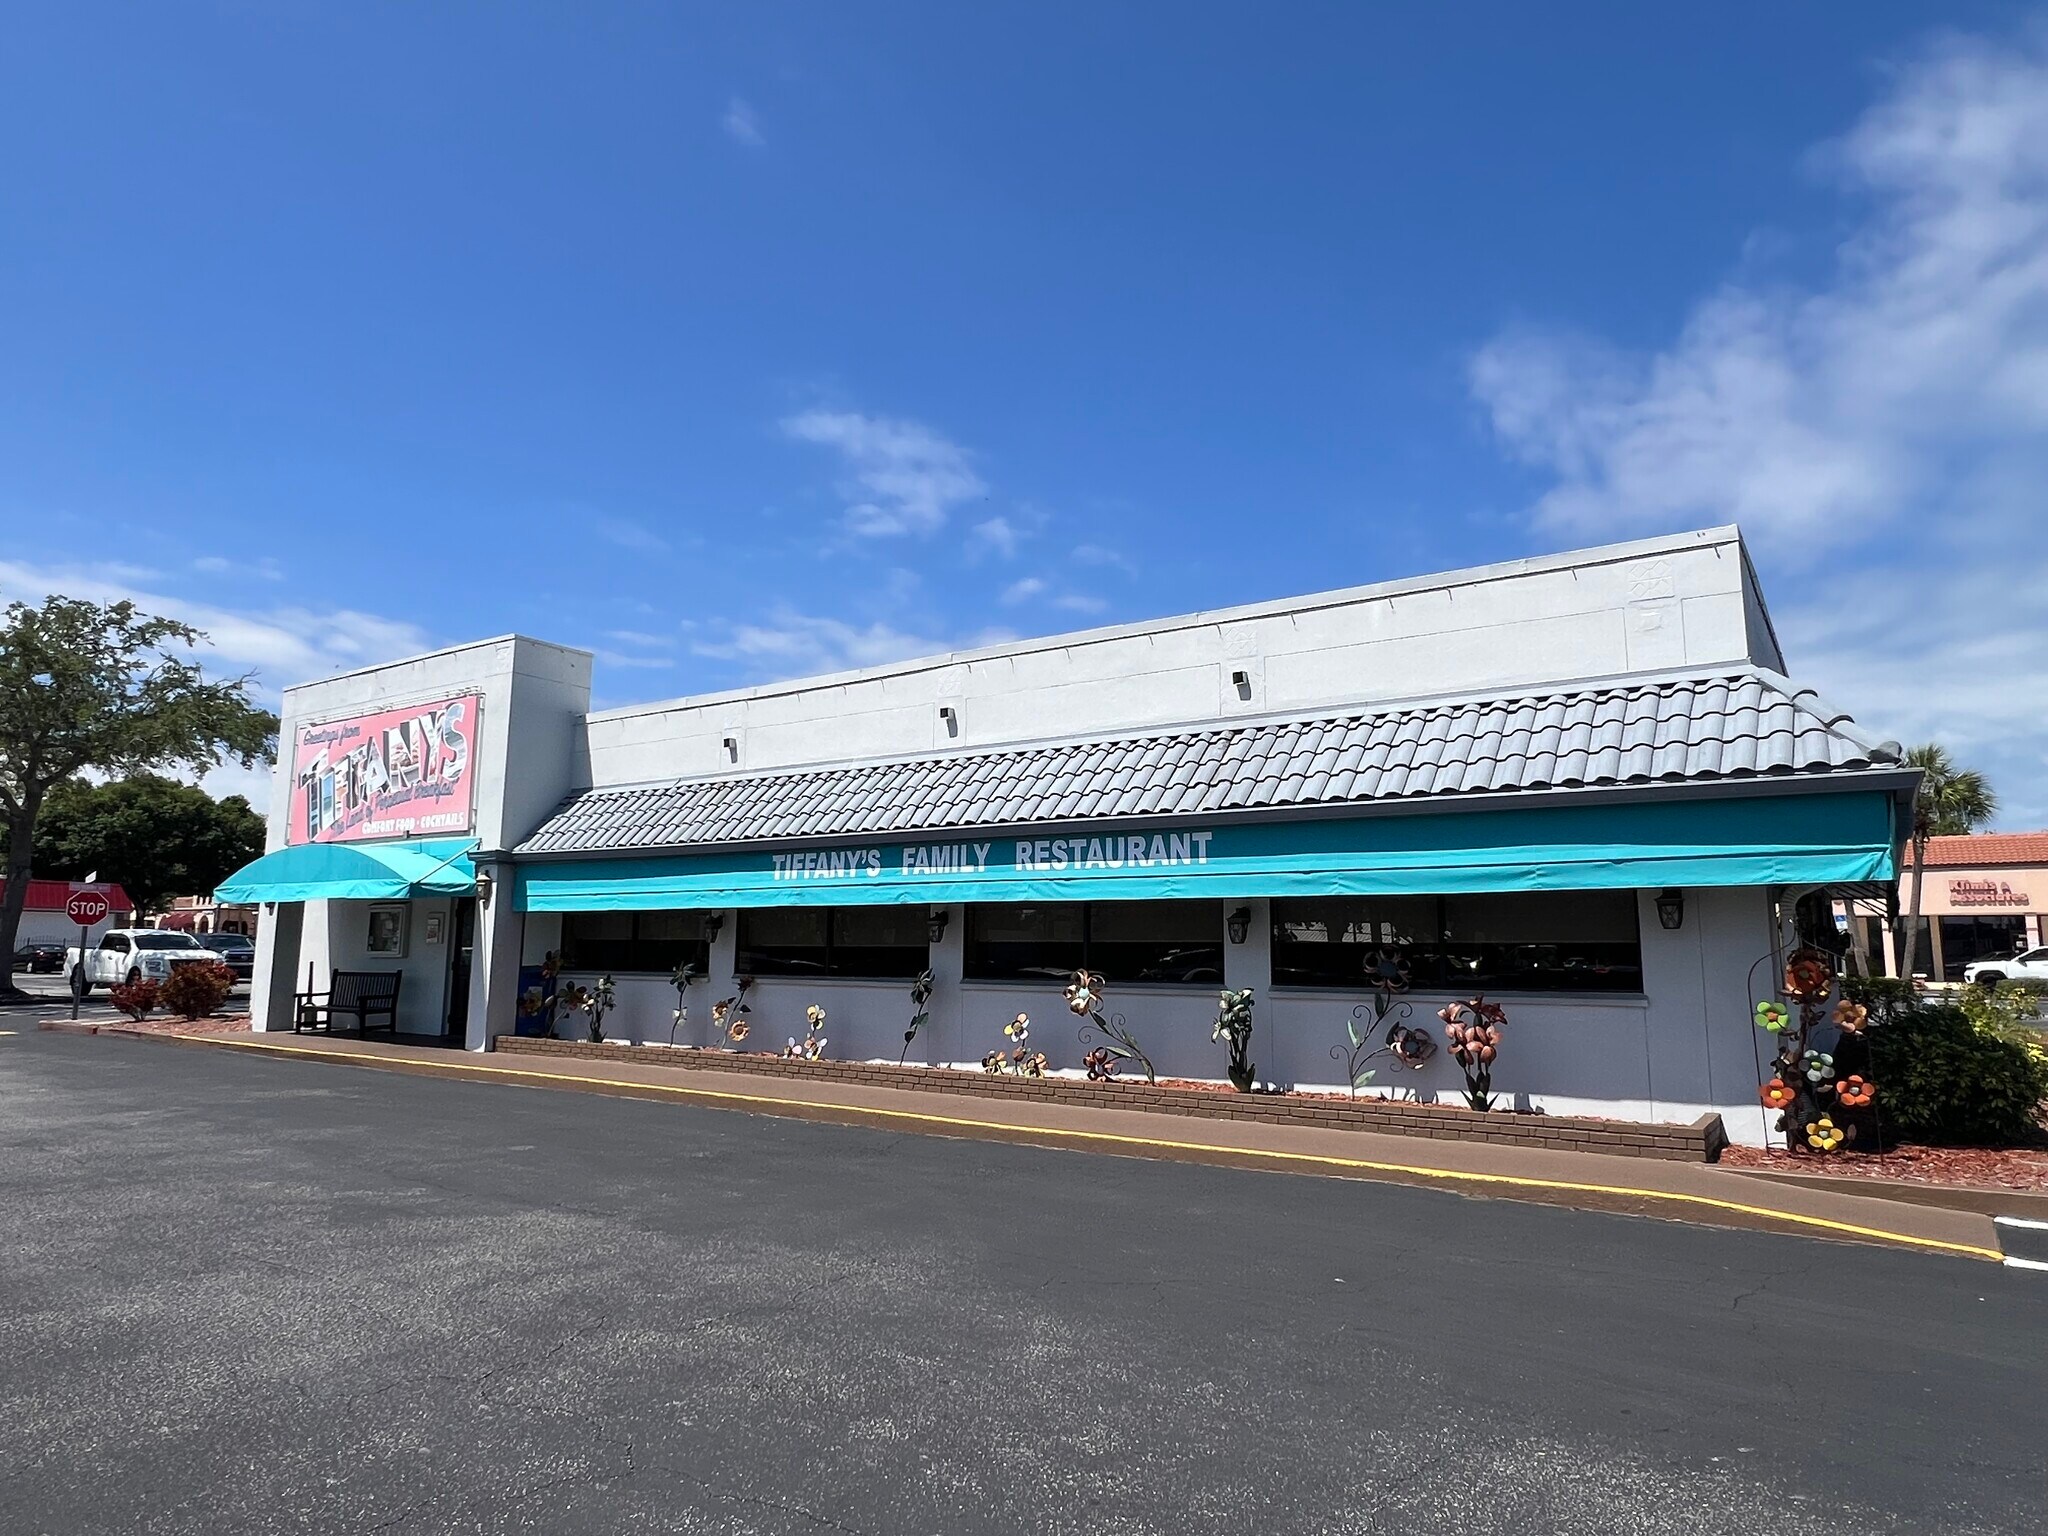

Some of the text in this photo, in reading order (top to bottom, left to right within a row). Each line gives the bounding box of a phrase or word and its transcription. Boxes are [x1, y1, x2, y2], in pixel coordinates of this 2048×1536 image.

[362, 812, 464, 835] COMFORT FOOD COCKTAILS
[772, 831, 1213, 881] TIFFANY'S FAMILY RESTAURANT
[70, 901, 106, 916] STOP
